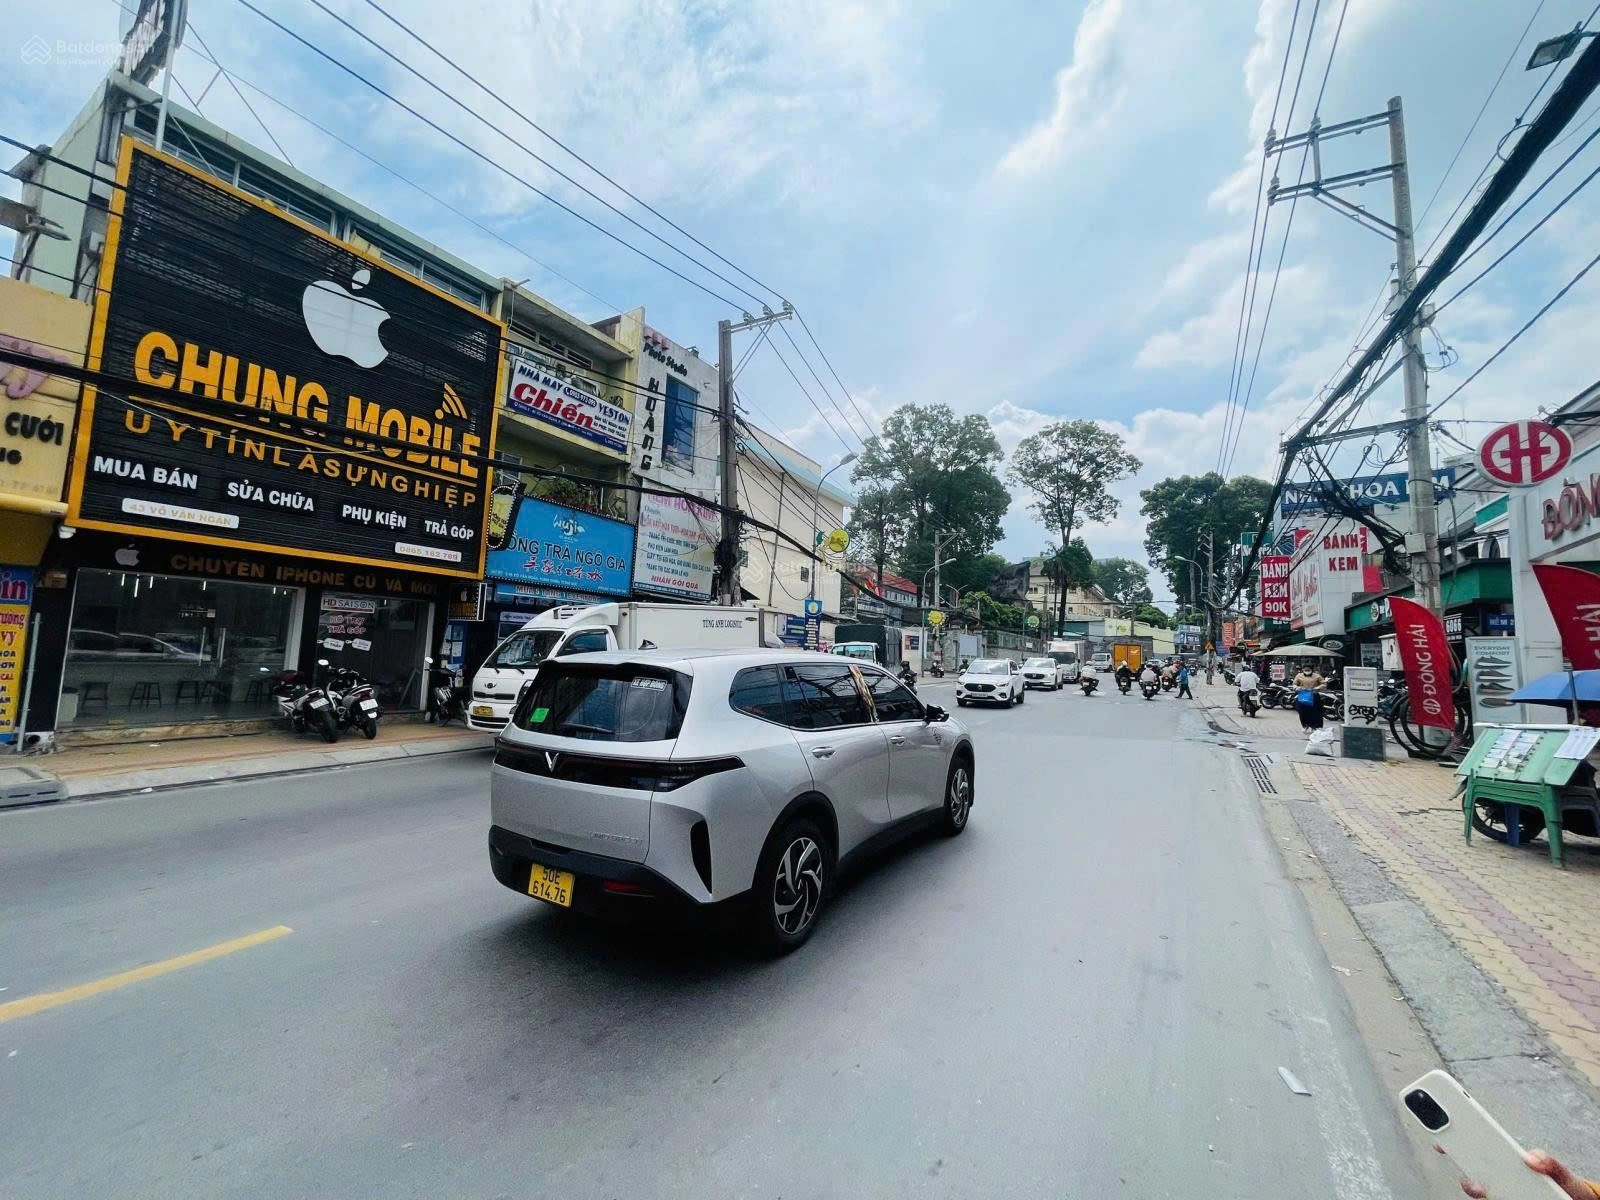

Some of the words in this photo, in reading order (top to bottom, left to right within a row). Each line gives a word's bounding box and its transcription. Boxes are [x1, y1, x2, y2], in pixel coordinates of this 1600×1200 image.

[643, 342, 666, 363] Photo
[134, 331, 329, 437] CHUNG
[346, 395, 481, 479] MOBILE
[514, 383, 593, 429] Chiến
[94, 455, 145, 480] MUA
[153, 467, 198, 490] BÁN
[227, 479, 264, 502] SỬA
[269, 491, 315, 512] CHỮA
[342, 504, 372, 525] PHỤ
[375, 511, 407, 530] KIỆN
[424, 519, 448, 536] TRẢ
[450, 525, 475, 541] GÓP
[1324, 532, 1359, 550] BÁNH
[1262, 559, 1289, 579] BÁNH
[1328, 556, 1359, 572] KEM
[275, 566, 345, 587] IPHONE
[1265, 602, 1288, 613] 90K
[532, 879, 572, 903] 614.76
